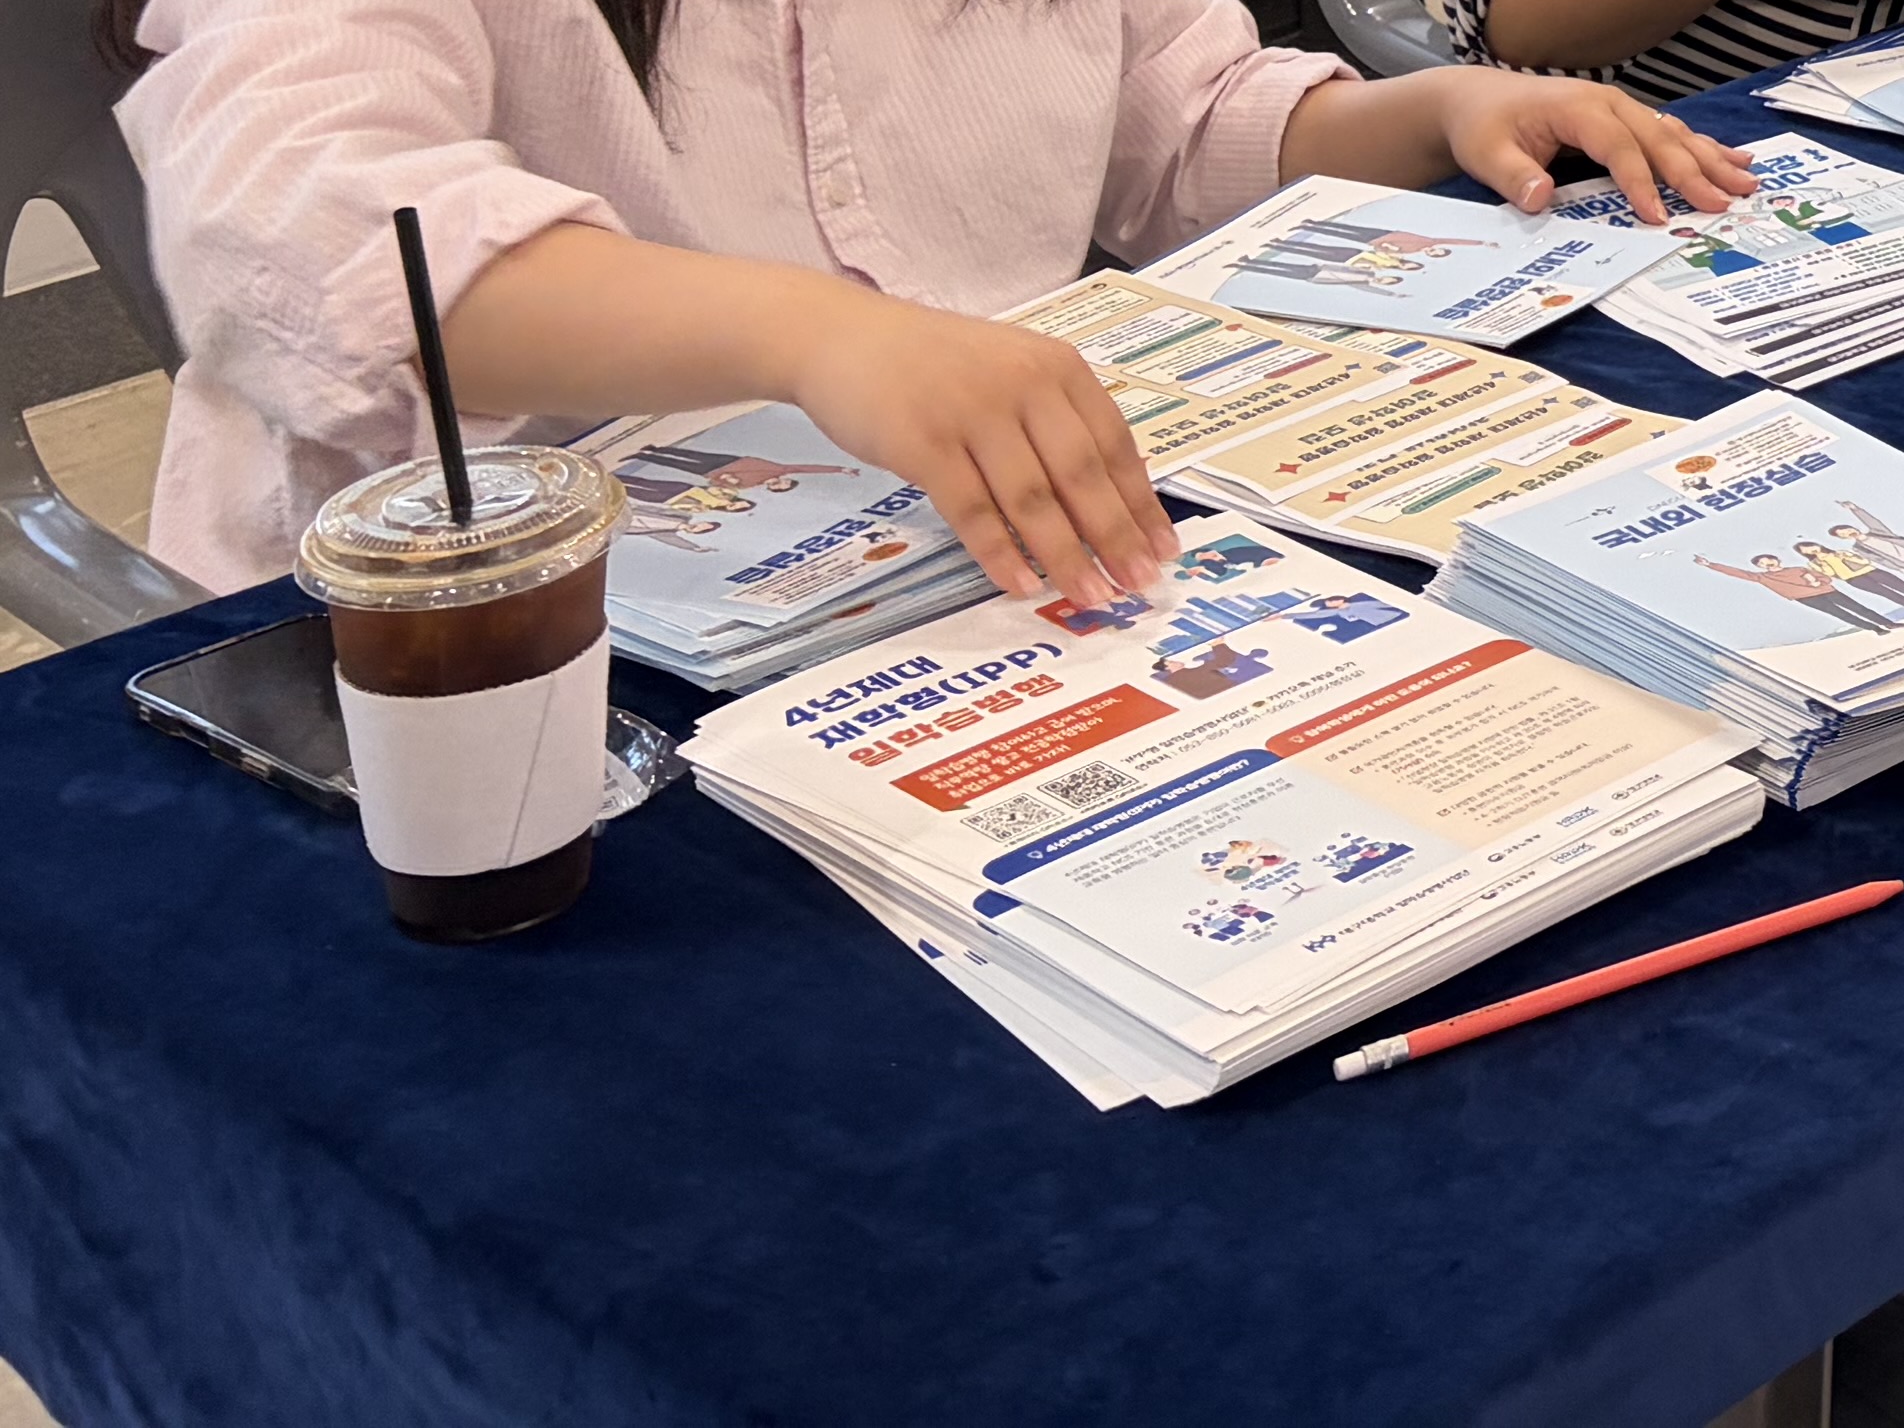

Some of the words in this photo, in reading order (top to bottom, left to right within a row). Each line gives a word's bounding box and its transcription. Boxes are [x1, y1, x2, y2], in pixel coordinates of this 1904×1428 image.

[1591, 504, 1706, 549] 국내외
[1696, 452, 1837, 512] 현장실습
[783, 656, 943, 728] 4년제대
[809, 643, 1064, 750] 재학형(IPP)
[848, 673, 1064, 767] 일학습병행
